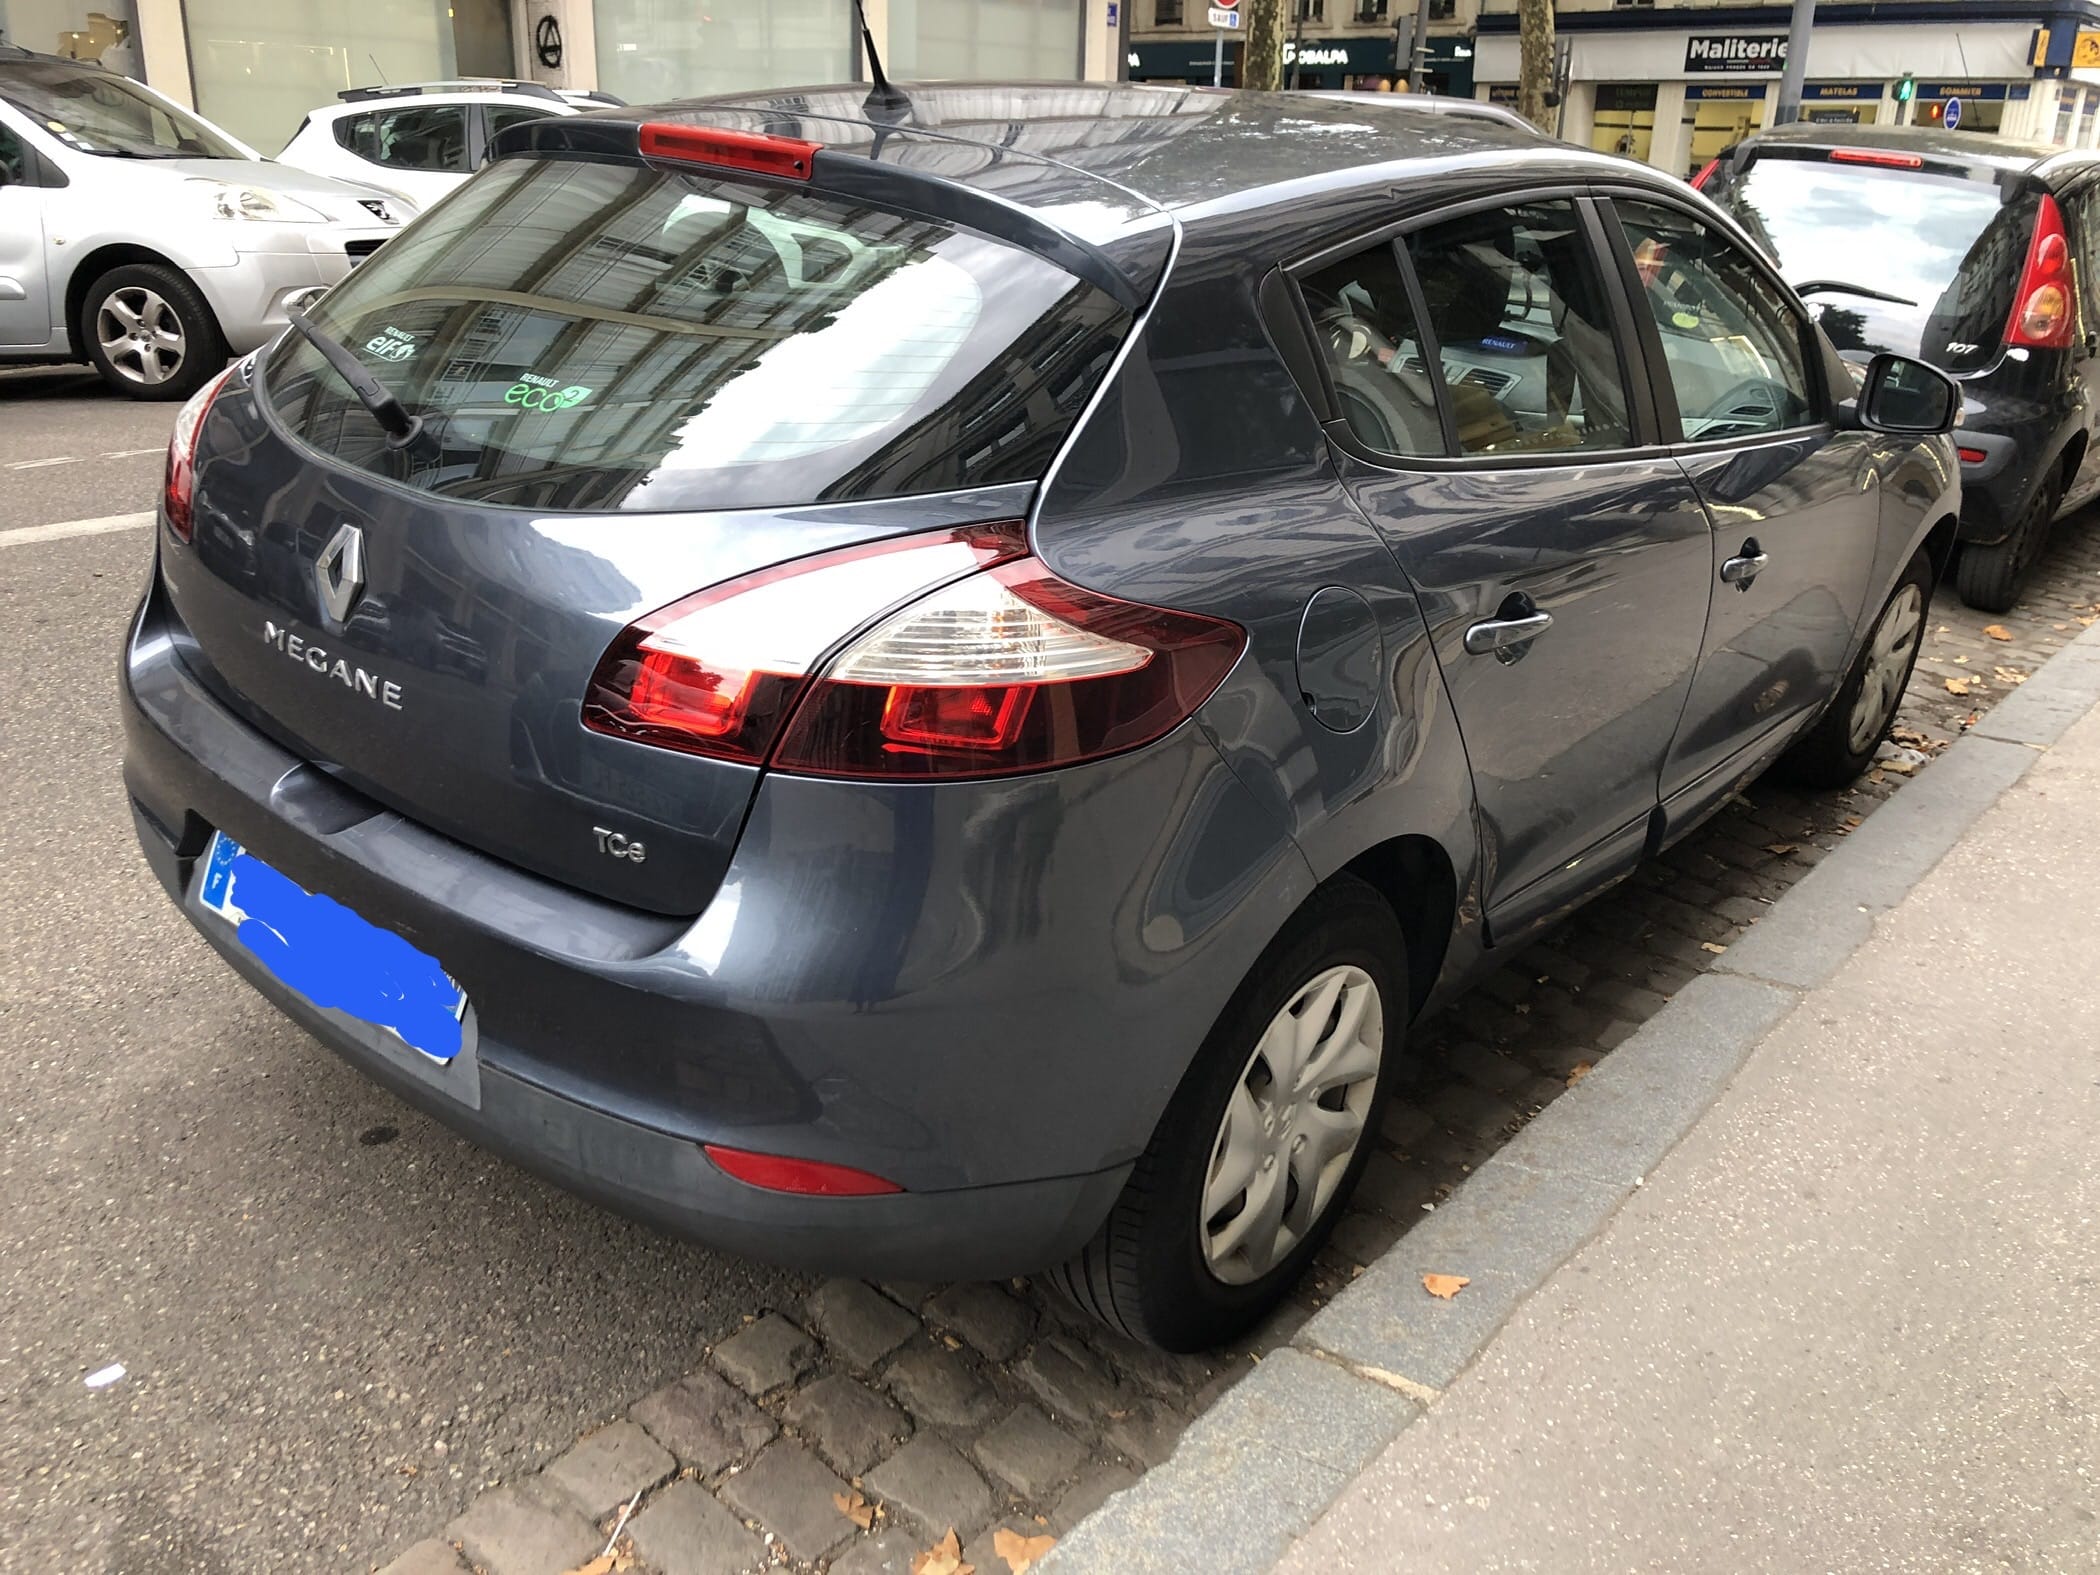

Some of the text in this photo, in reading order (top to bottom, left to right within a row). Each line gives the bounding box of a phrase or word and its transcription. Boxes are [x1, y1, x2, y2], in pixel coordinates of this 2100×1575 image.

[1820, 87, 1858, 97] MATELAS
[1945, 341, 1979, 354] 107
[519, 372, 560, 388] RENAULT
[264, 620, 403, 710] MEGANE
[592, 826, 647, 863] TCe
[211, 872, 223, 889] F
